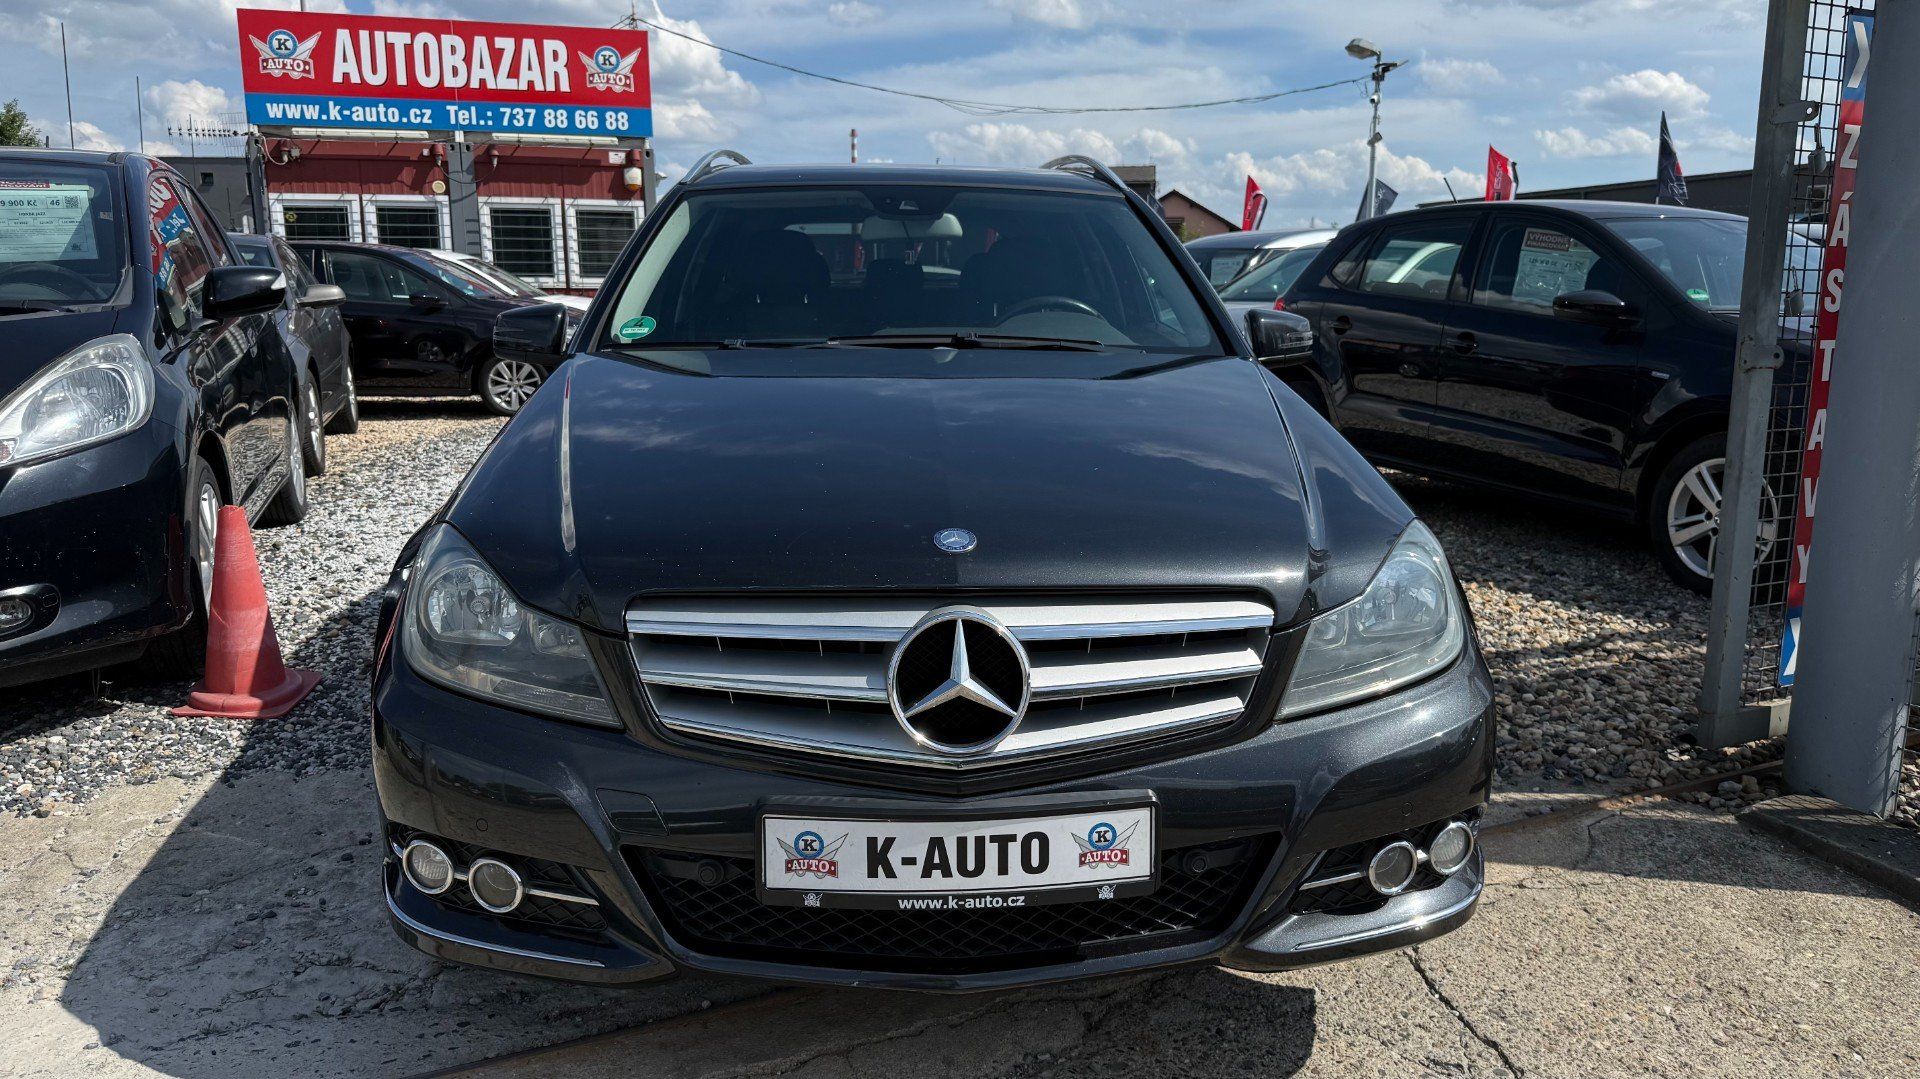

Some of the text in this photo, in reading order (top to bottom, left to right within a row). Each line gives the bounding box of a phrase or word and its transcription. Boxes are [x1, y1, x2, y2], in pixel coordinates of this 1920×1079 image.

[276, 37, 291, 51] K
[266, 57, 305, 71] AUTO
[332, 28, 571, 92] AUTOBAZAR
[601, 54, 614, 66] K
[593, 73, 626, 86] AUTO
[265, 101, 629, 131] www.k-auto.cz Tel.: 737 88 66 88
[8, 199, 24, 207] 900
[1095, 830, 1111, 843] K
[801, 838, 817, 852] K
[866, 831, 1050, 878] K-AUTO
[1085, 848, 1123, 863] AUTO
[791, 858, 829, 872] AUTO
[898, 894, 1026, 910] www.k-auto.cz
